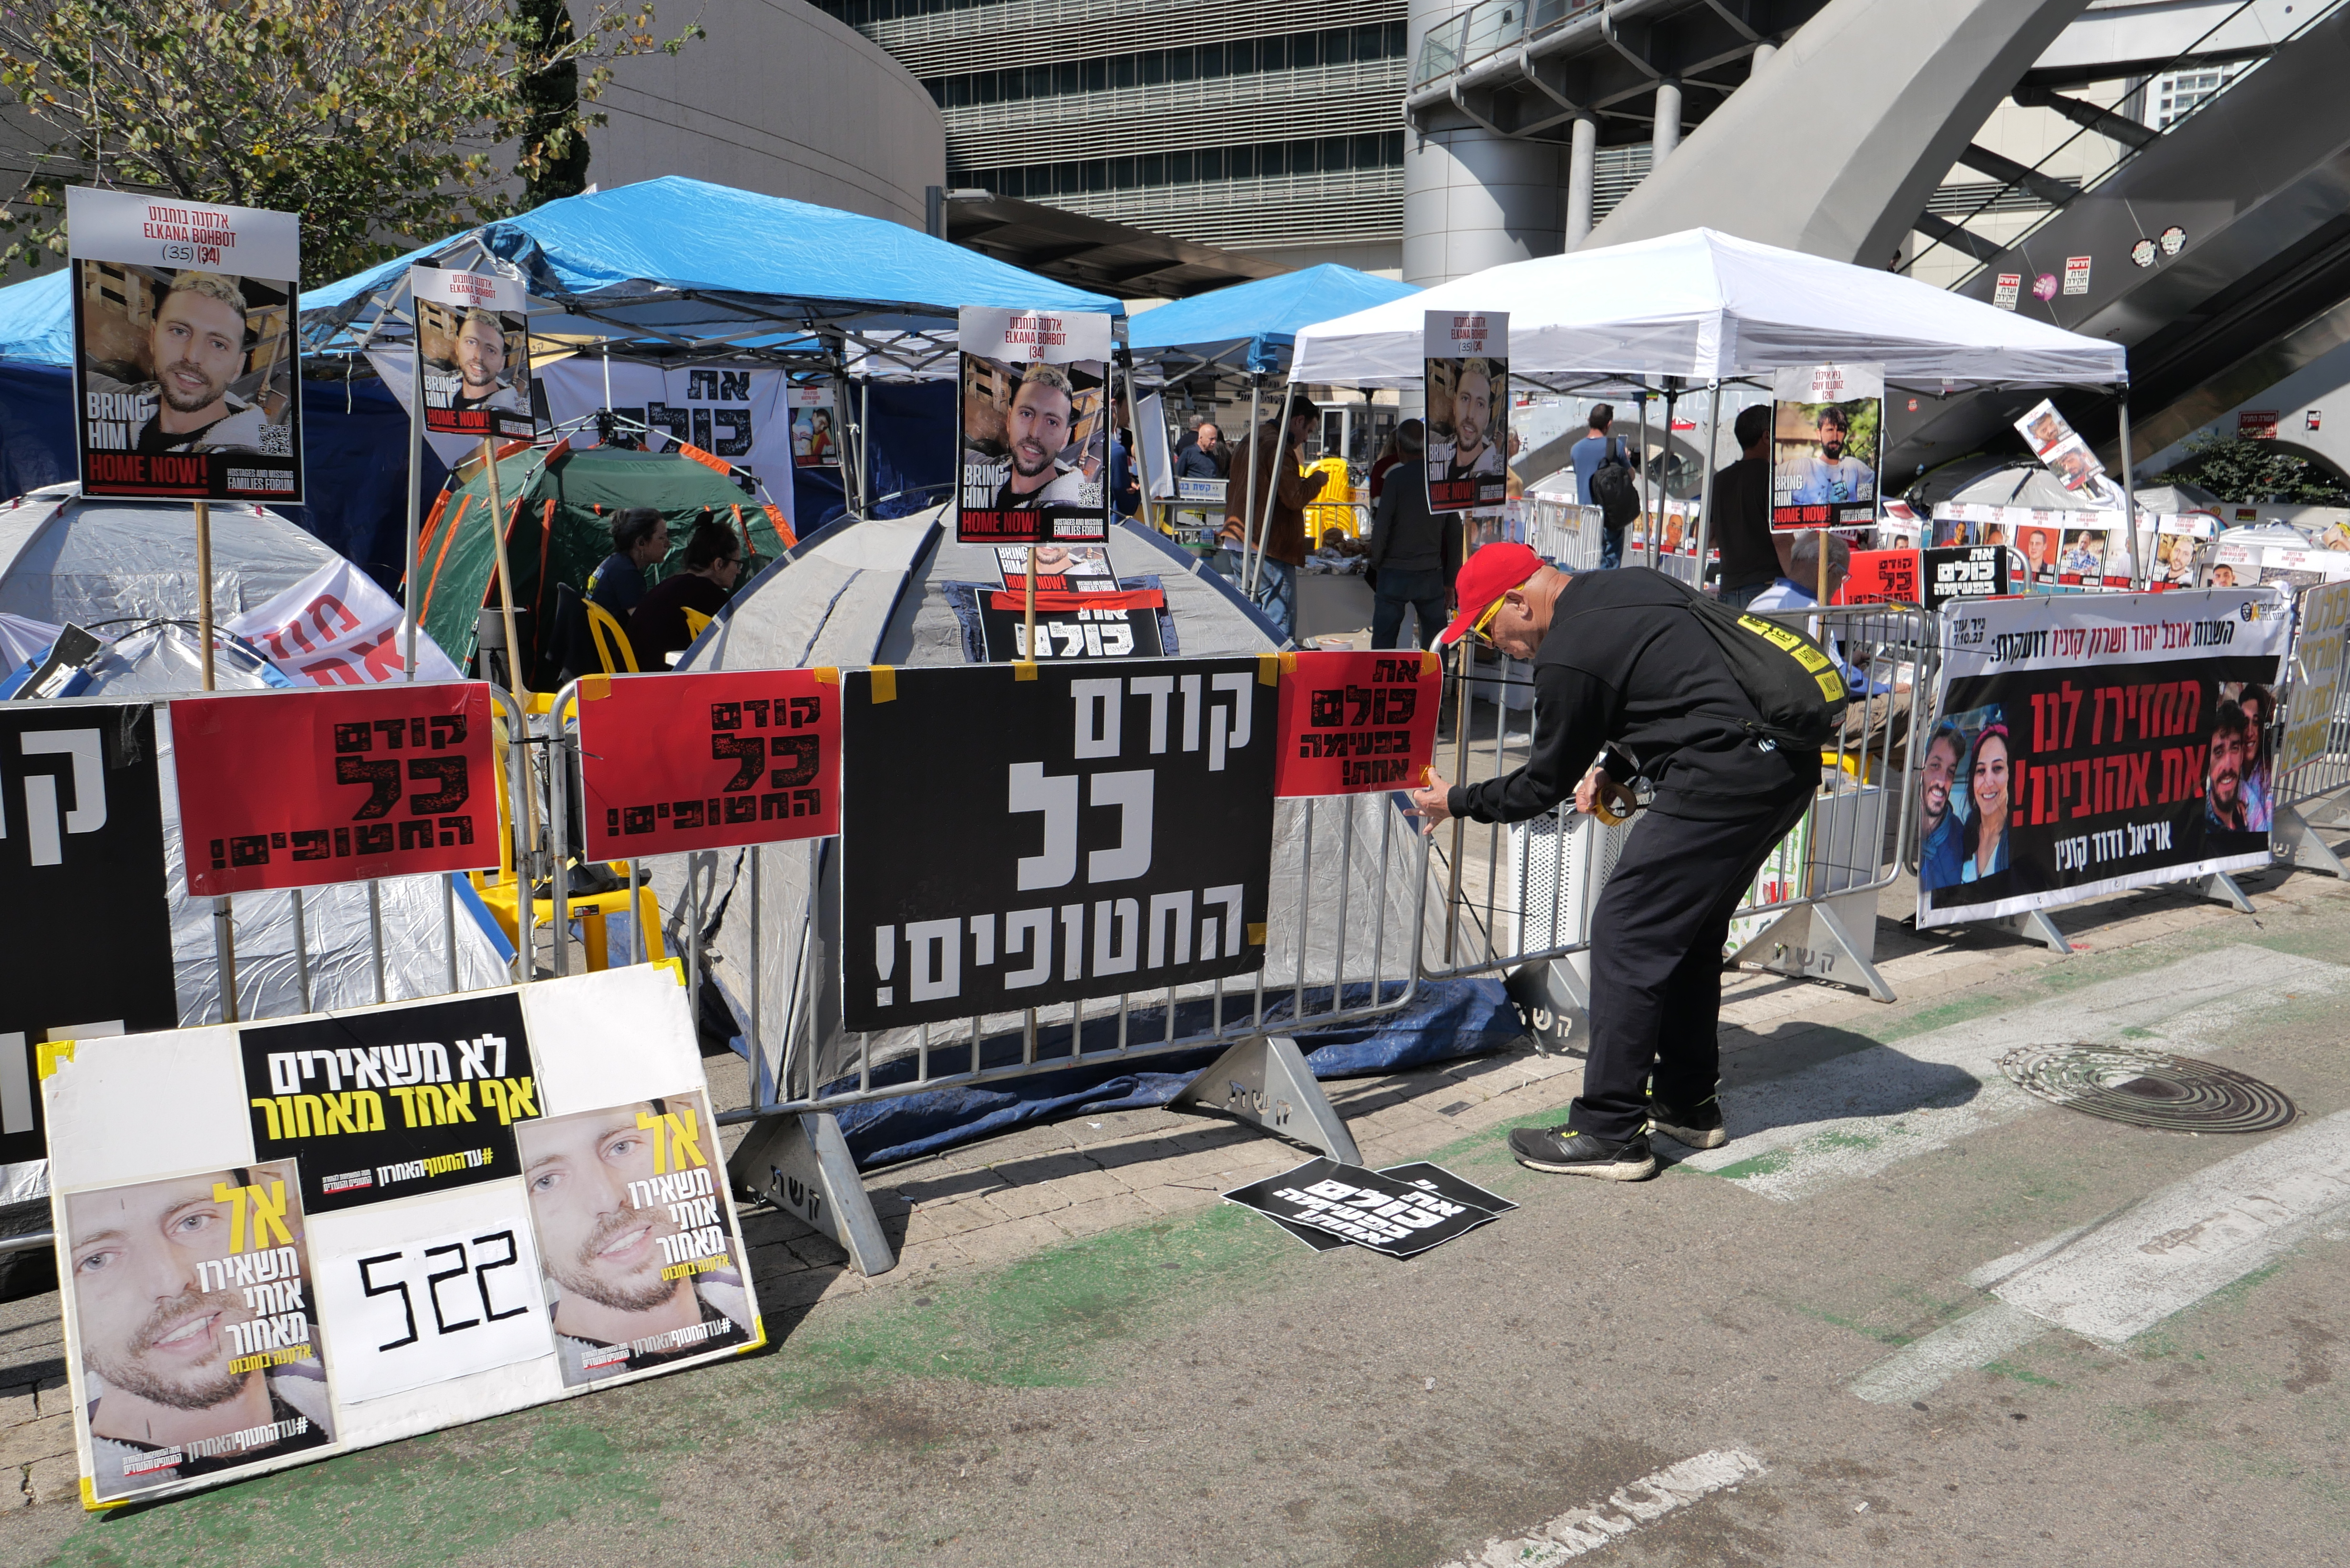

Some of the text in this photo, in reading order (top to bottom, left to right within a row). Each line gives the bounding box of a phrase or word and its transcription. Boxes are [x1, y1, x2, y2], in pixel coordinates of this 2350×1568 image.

[148, 205, 230, 230] אלקנה בוחבוט
[143, 221, 237, 248] ELKANA BOHBOT
[162, 244, 194, 263] (35)
[450, 284, 496, 299] ELKANA BOHBOT
[470, 295, 482, 306] (34)
[1005, 330, 1066, 346] ELKANA BOHBOT
[1010, 316, 1062, 332] אלקנה בוחבוט
[1451, 329, 1487, 340] ELKANA BOHBOT
[1029, 345, 1045, 360] (34)
[1458, 342, 1472, 353] (35)
[424, 375, 458, 392] BRING
[687, 370, 750, 401] את
[1812, 380, 1844, 391] GUY ILLOUZ
[1822, 390, 1834, 400] (26)
[88, 391, 148, 422] BRING
[426, 391, 447, 408] HIM
[428, 409, 456, 426] HOME
[459, 410, 490, 428] NOW!
[88, 421, 128, 450] HIM
[1429, 443, 1453, 462] BRING
[88, 454, 209, 485] HOME NOW!
[227, 468, 256, 477] HOSTAGES
[268, 470, 294, 479] MISSING
[964, 464, 1005, 486] BRING
[1429, 462, 1444, 481] HIM
[1774, 475, 1804, 491] BRING
[227, 477, 294, 491] FAMILIES FORUM
[963, 487, 989, 508] HIM
[1430, 483, 1450, 500] HOME
[1452, 480, 1474, 499] NOW!
[1774, 491, 1792, 506] HIM
[962, 509, 1041, 533] HOME NOW!
[1053, 518, 1075, 526] HOSTAGES
[1774, 506, 1801, 523] HOME
[1802, 504, 1831, 521] NOW!
[1053, 526, 1103, 536] FAMILIES FORUM
[999, 547, 1028, 560] BRING
[1003, 559, 1023, 574] HIM
[1878, 557, 1913, 569] קודם
[1969, 547, 1995, 561] את
[1036, 574, 1068, 590] NOW!
[1878, 571, 1912, 591] כל
[1938, 560, 1995, 582] כולם
[1934, 580, 1996, 596] בפעימה
[1014, 621, 1134, 656] כולם
[1953, 618, 1986, 632] ניר עוז
[1954, 631, 1984, 646] 7.10.23
[2131, 624, 2157, 652] יהוד
[2162, 619, 2191, 650] ארבל
[2052, 628, 2087, 660] קוניו
[2087, 626, 2127, 660] ושרון
[1372, 659, 1421, 682] את
[711, 696, 821, 731] קודם
[1310, 684, 1417, 727] כולם
[2030, 679, 2202, 753] תחזירו לנו
[334, 714, 468, 754] קודם
[1070, 671, 1253, 772] קודם
[1299, 730, 1411, 758] בפעימה
[711, 732, 820, 793] כל
[1342, 758, 1410, 786] אחת!
[336, 754, 469, 821] כל
[2012, 744, 2207, 827] את אהובינו!
[607, 788, 821, 836] החטופים!
[1008, 761, 1154, 891] כל
[211, 815, 474, 870] החטופים!
[2054, 820, 2173, 873] אריאל ודוד קוניו
[875, 883, 1244, 1007] החטופים!
[1772, 942, 1835, 974] קשת
[268, 1033, 507, 1095] לא משאירים
[251, 1076, 539, 1140] אף אחד מאחור
[1228, 1080, 1292, 1126] קשת
[635, 1108, 708, 1176] אל
[376, 1147, 494, 1187] #עדהחטוףהאחרון
[628, 1167, 714, 1210] תשאירו
[770, 1165, 821, 1221] קשת
[667, 1195, 721, 1232] אותי
[1272, 1187, 1414, 1239] בפעימה
[1303, 1178, 1446, 1228] כולם
[1398, 1190, 1467, 1217] את
[212, 1180, 295, 1255] אל
[1292, 1209, 1395, 1245] אחת!
[655, 1225, 727, 1265] מאחור
[196, 1246, 300, 1293] תשאירו
[660, 1253, 731, 1281] אלקנה בוחבוט
[244, 1278, 306, 1317] אותי
[357, 1229, 530, 1352] 522
[225, 1311, 309, 1356] מאחור
[227, 1344, 312, 1375] אלקנה בוחבוט
[186, 1416, 309, 1463] #עדהחטוףהאחרון
